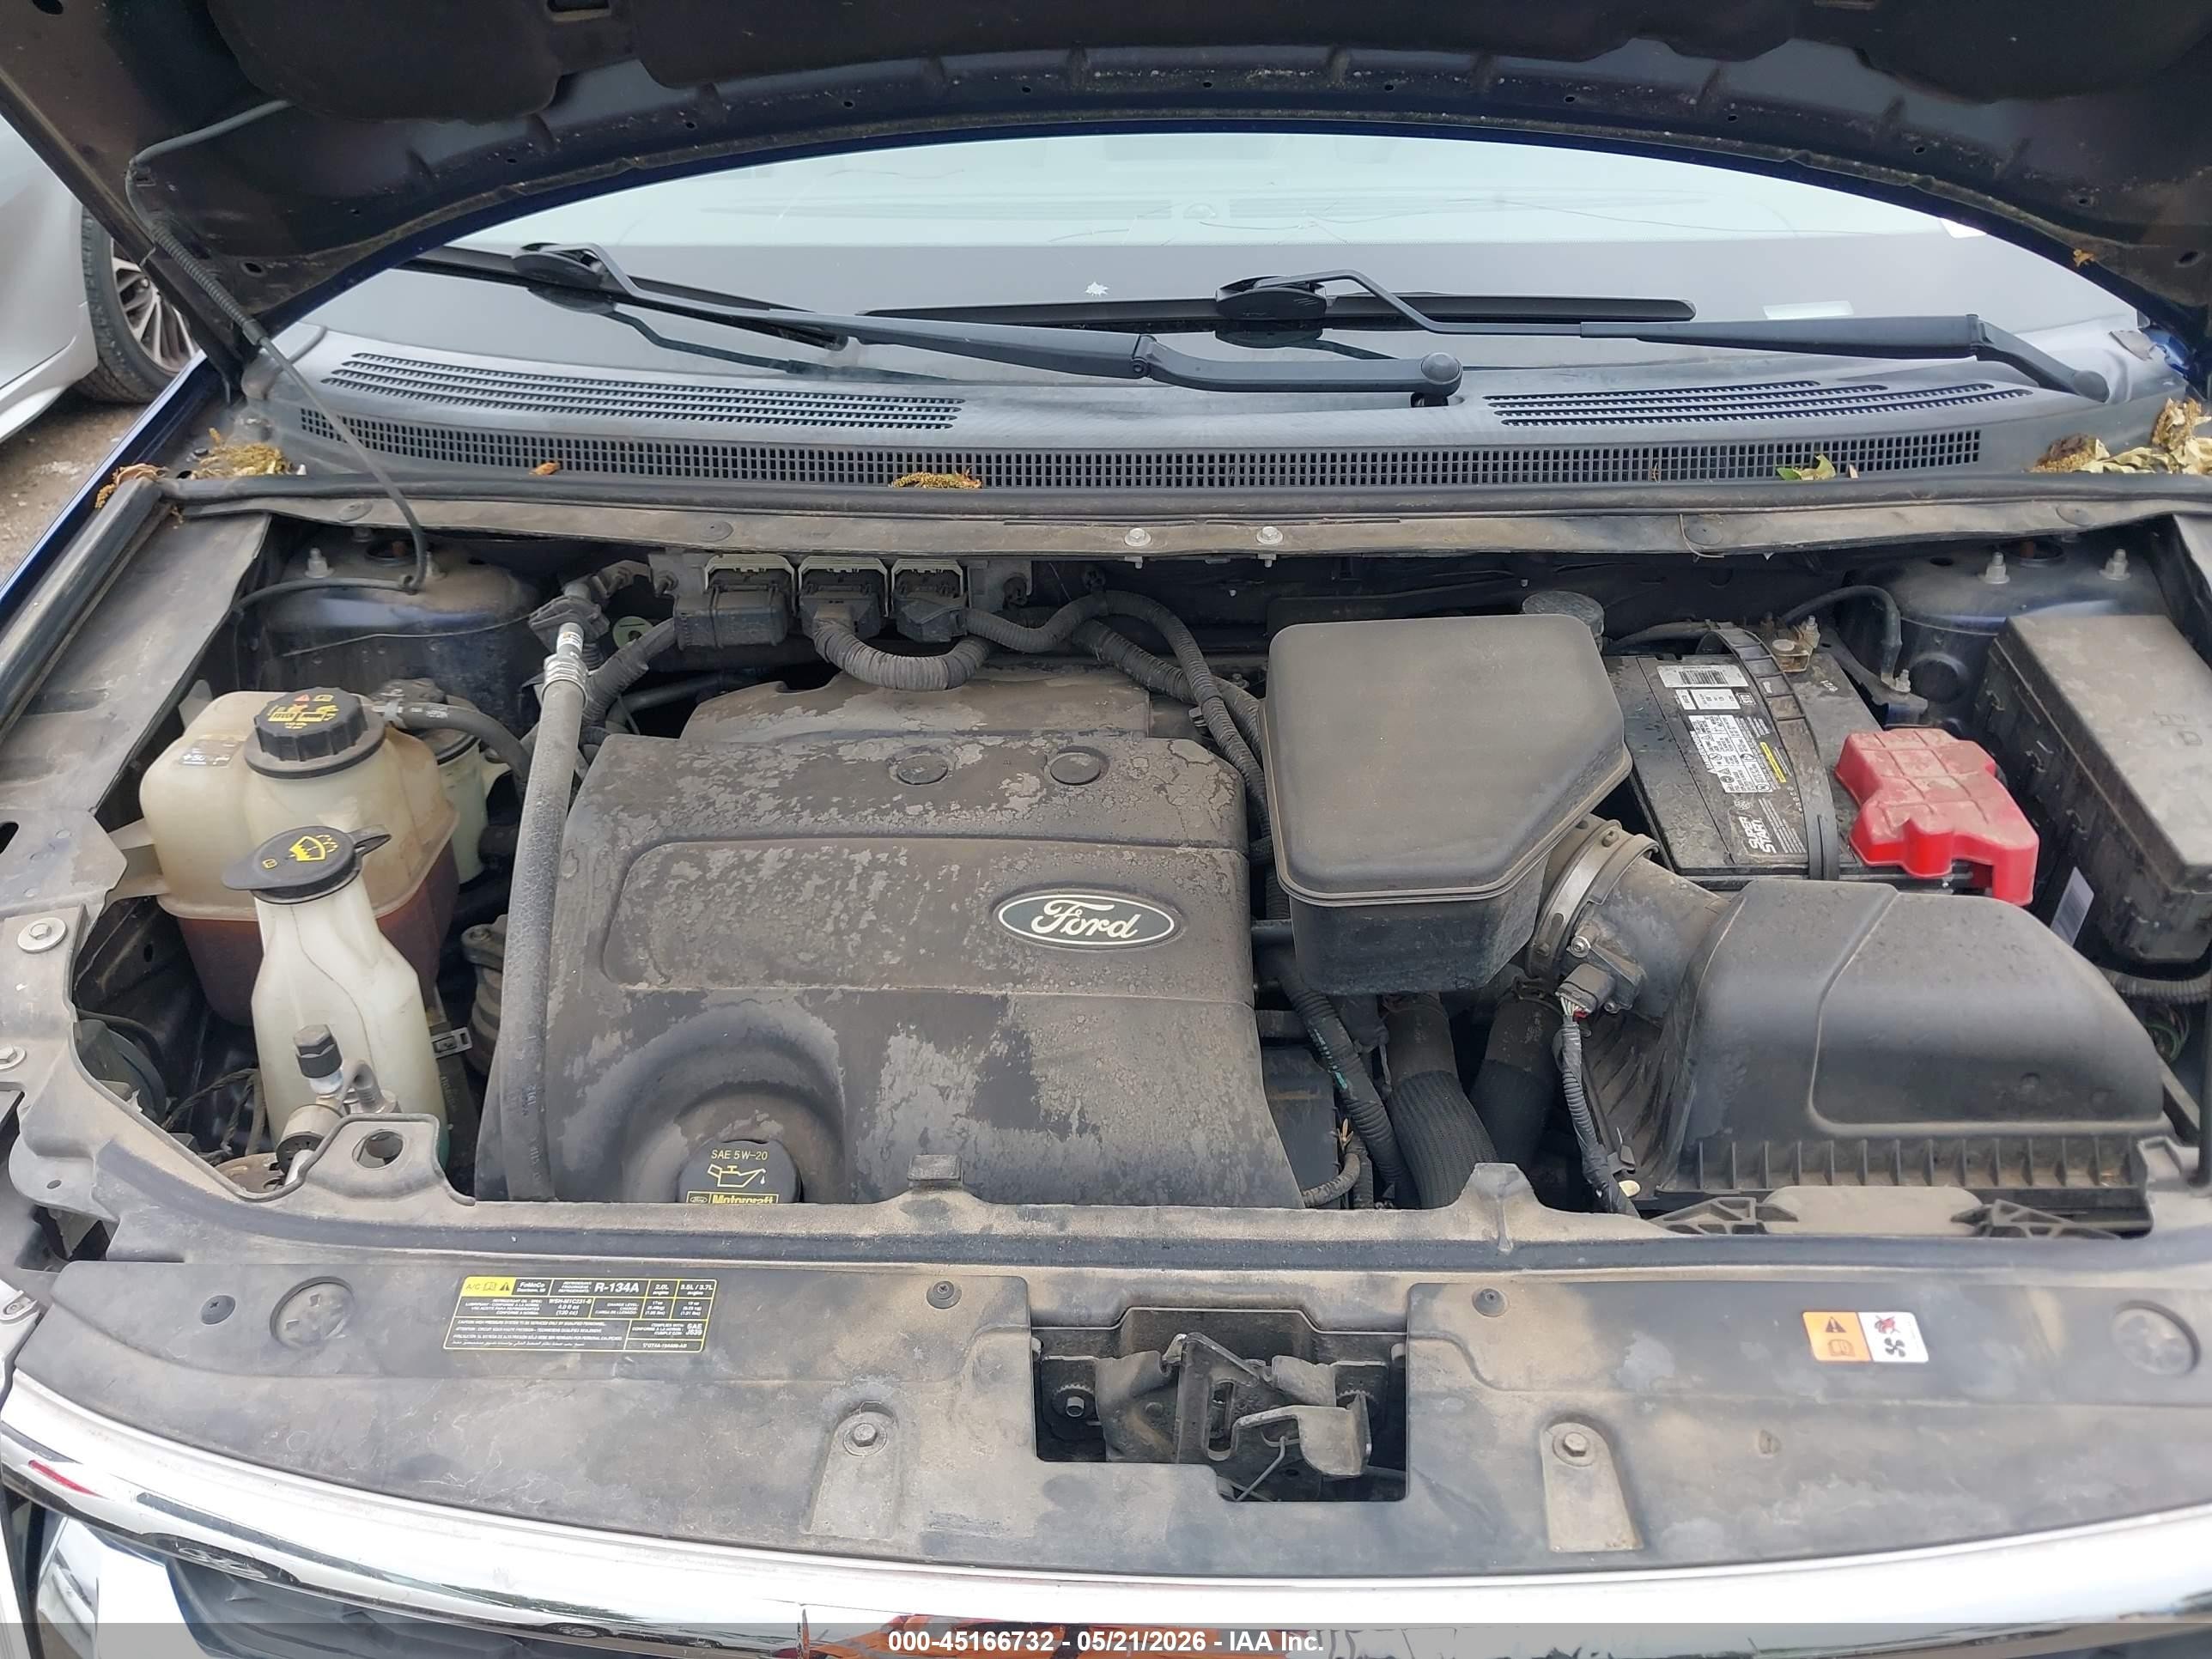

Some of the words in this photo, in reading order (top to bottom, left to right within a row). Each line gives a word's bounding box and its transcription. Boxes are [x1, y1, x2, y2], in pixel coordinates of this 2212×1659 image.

[1739, 817, 1759, 848] SUPER
[1031, 899, 1141, 939] Ford
[711, 1150, 732, 1160] SAE
[733, 1150, 769, 1161] 5W-20
[712, 1194, 774, 1204] Motorcraft
[594, 1282, 640, 1293] R-134A
